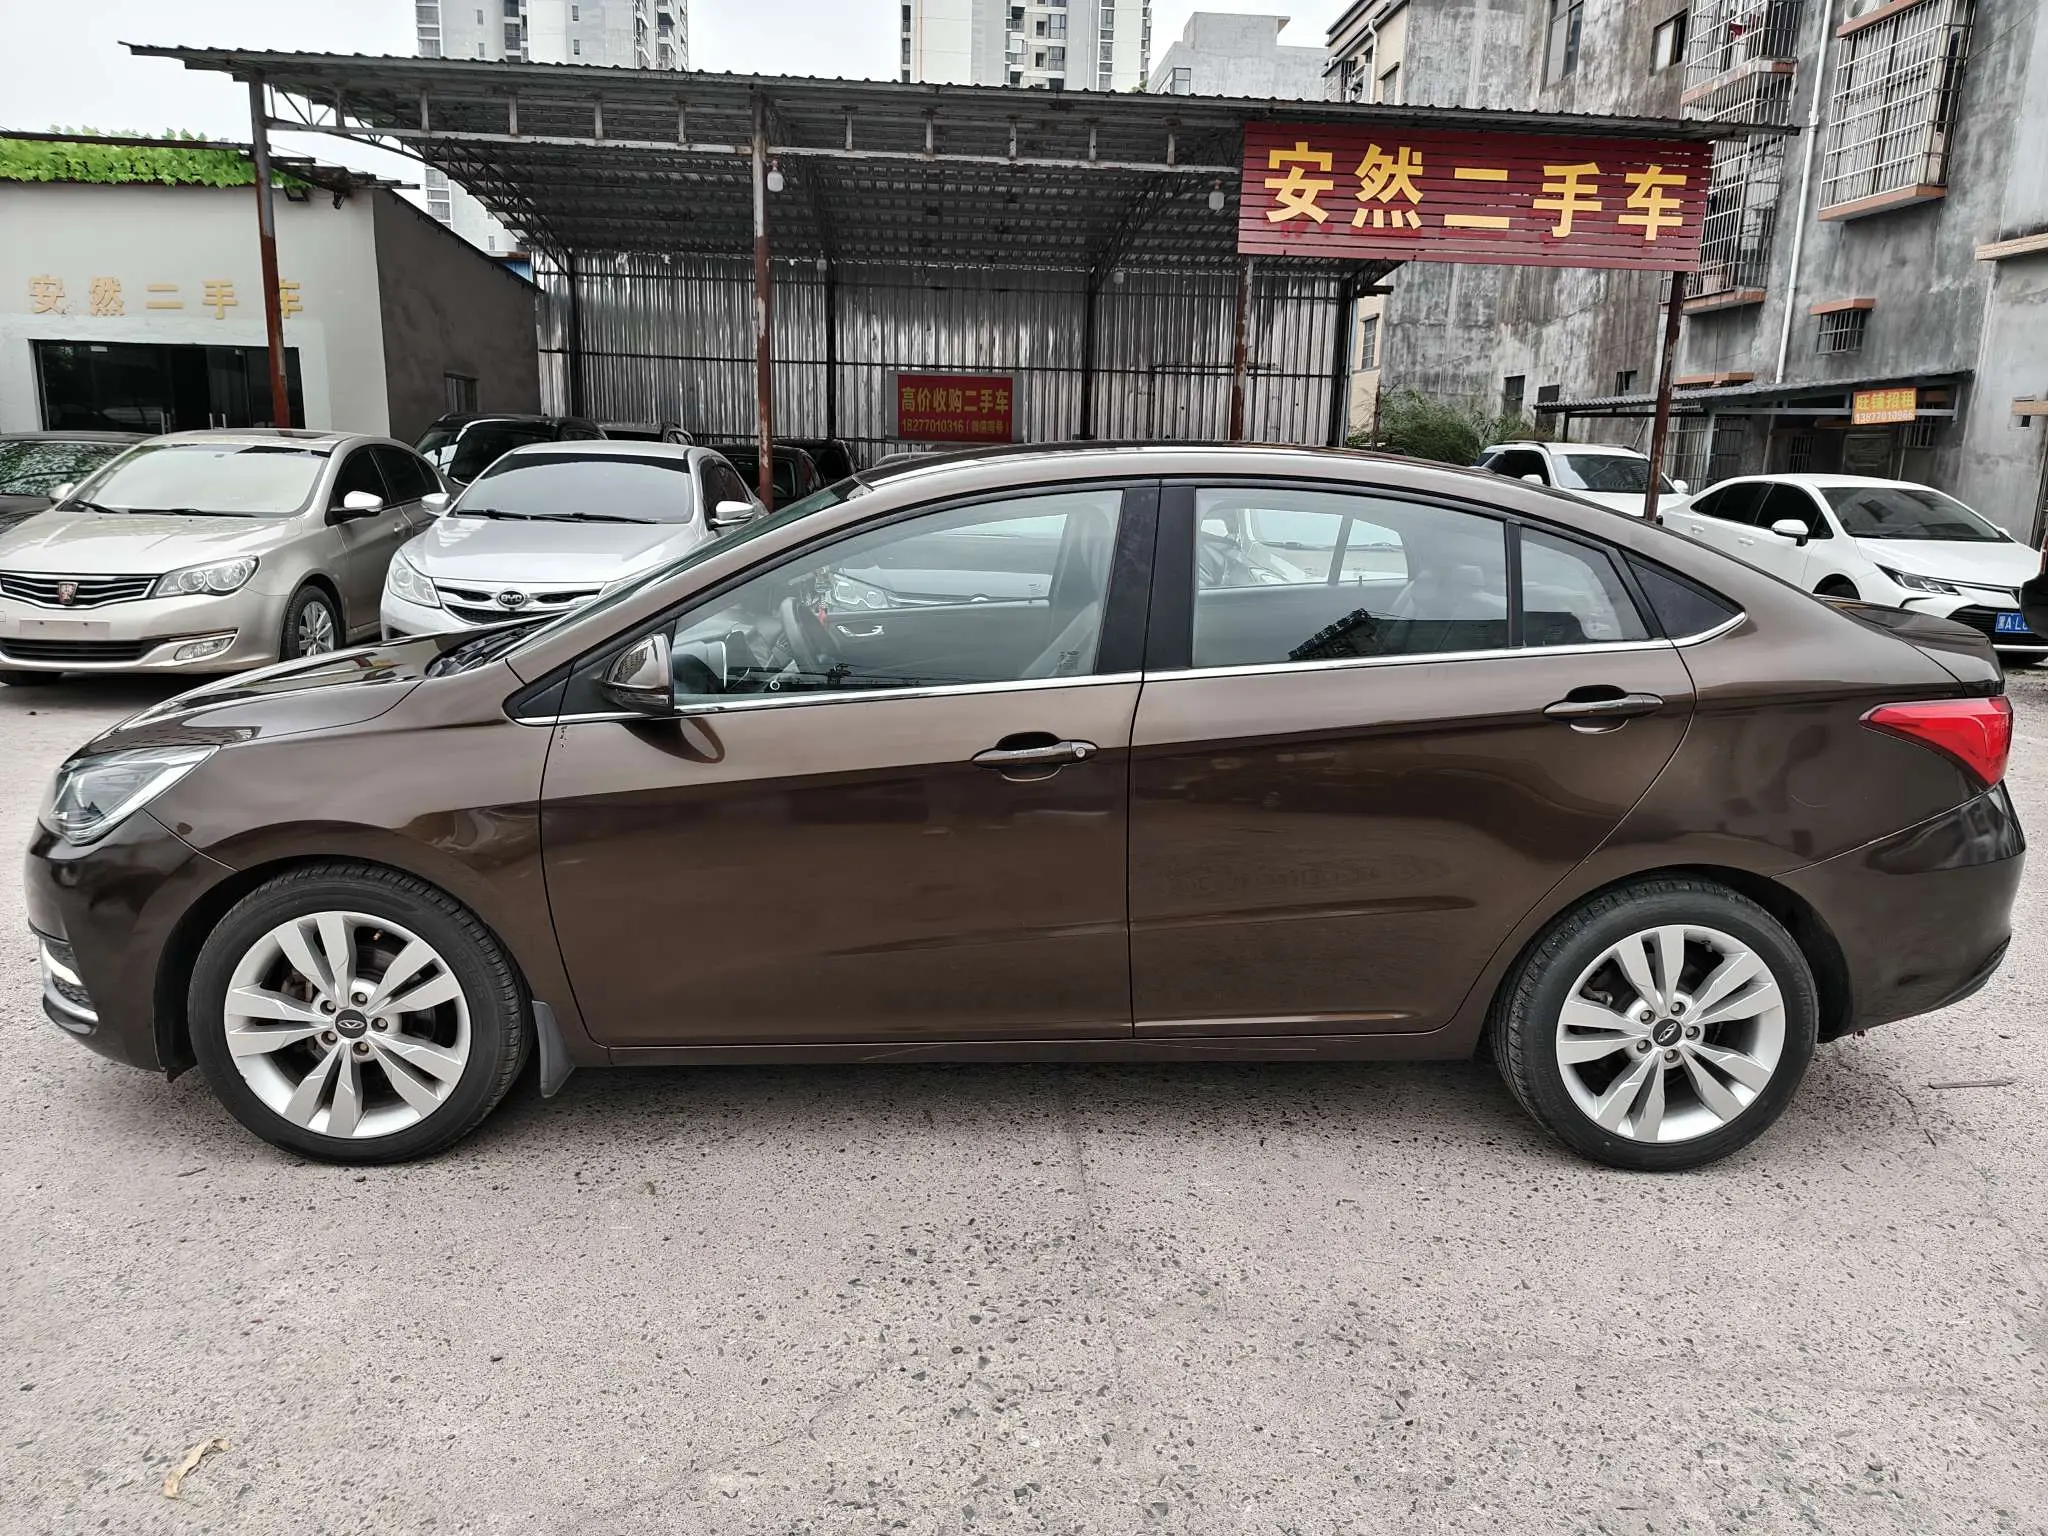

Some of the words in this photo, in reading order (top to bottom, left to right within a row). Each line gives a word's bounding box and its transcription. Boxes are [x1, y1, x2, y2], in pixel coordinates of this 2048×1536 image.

[1264, 141, 1687, 241] 安然二手车
[29, 274, 302, 320] 安然二手车
[901, 386, 1009, 414] 高价收购二手车
[1856, 390, 1915, 410] 旺铺招租
[501, 594, 522, 602] BYD
